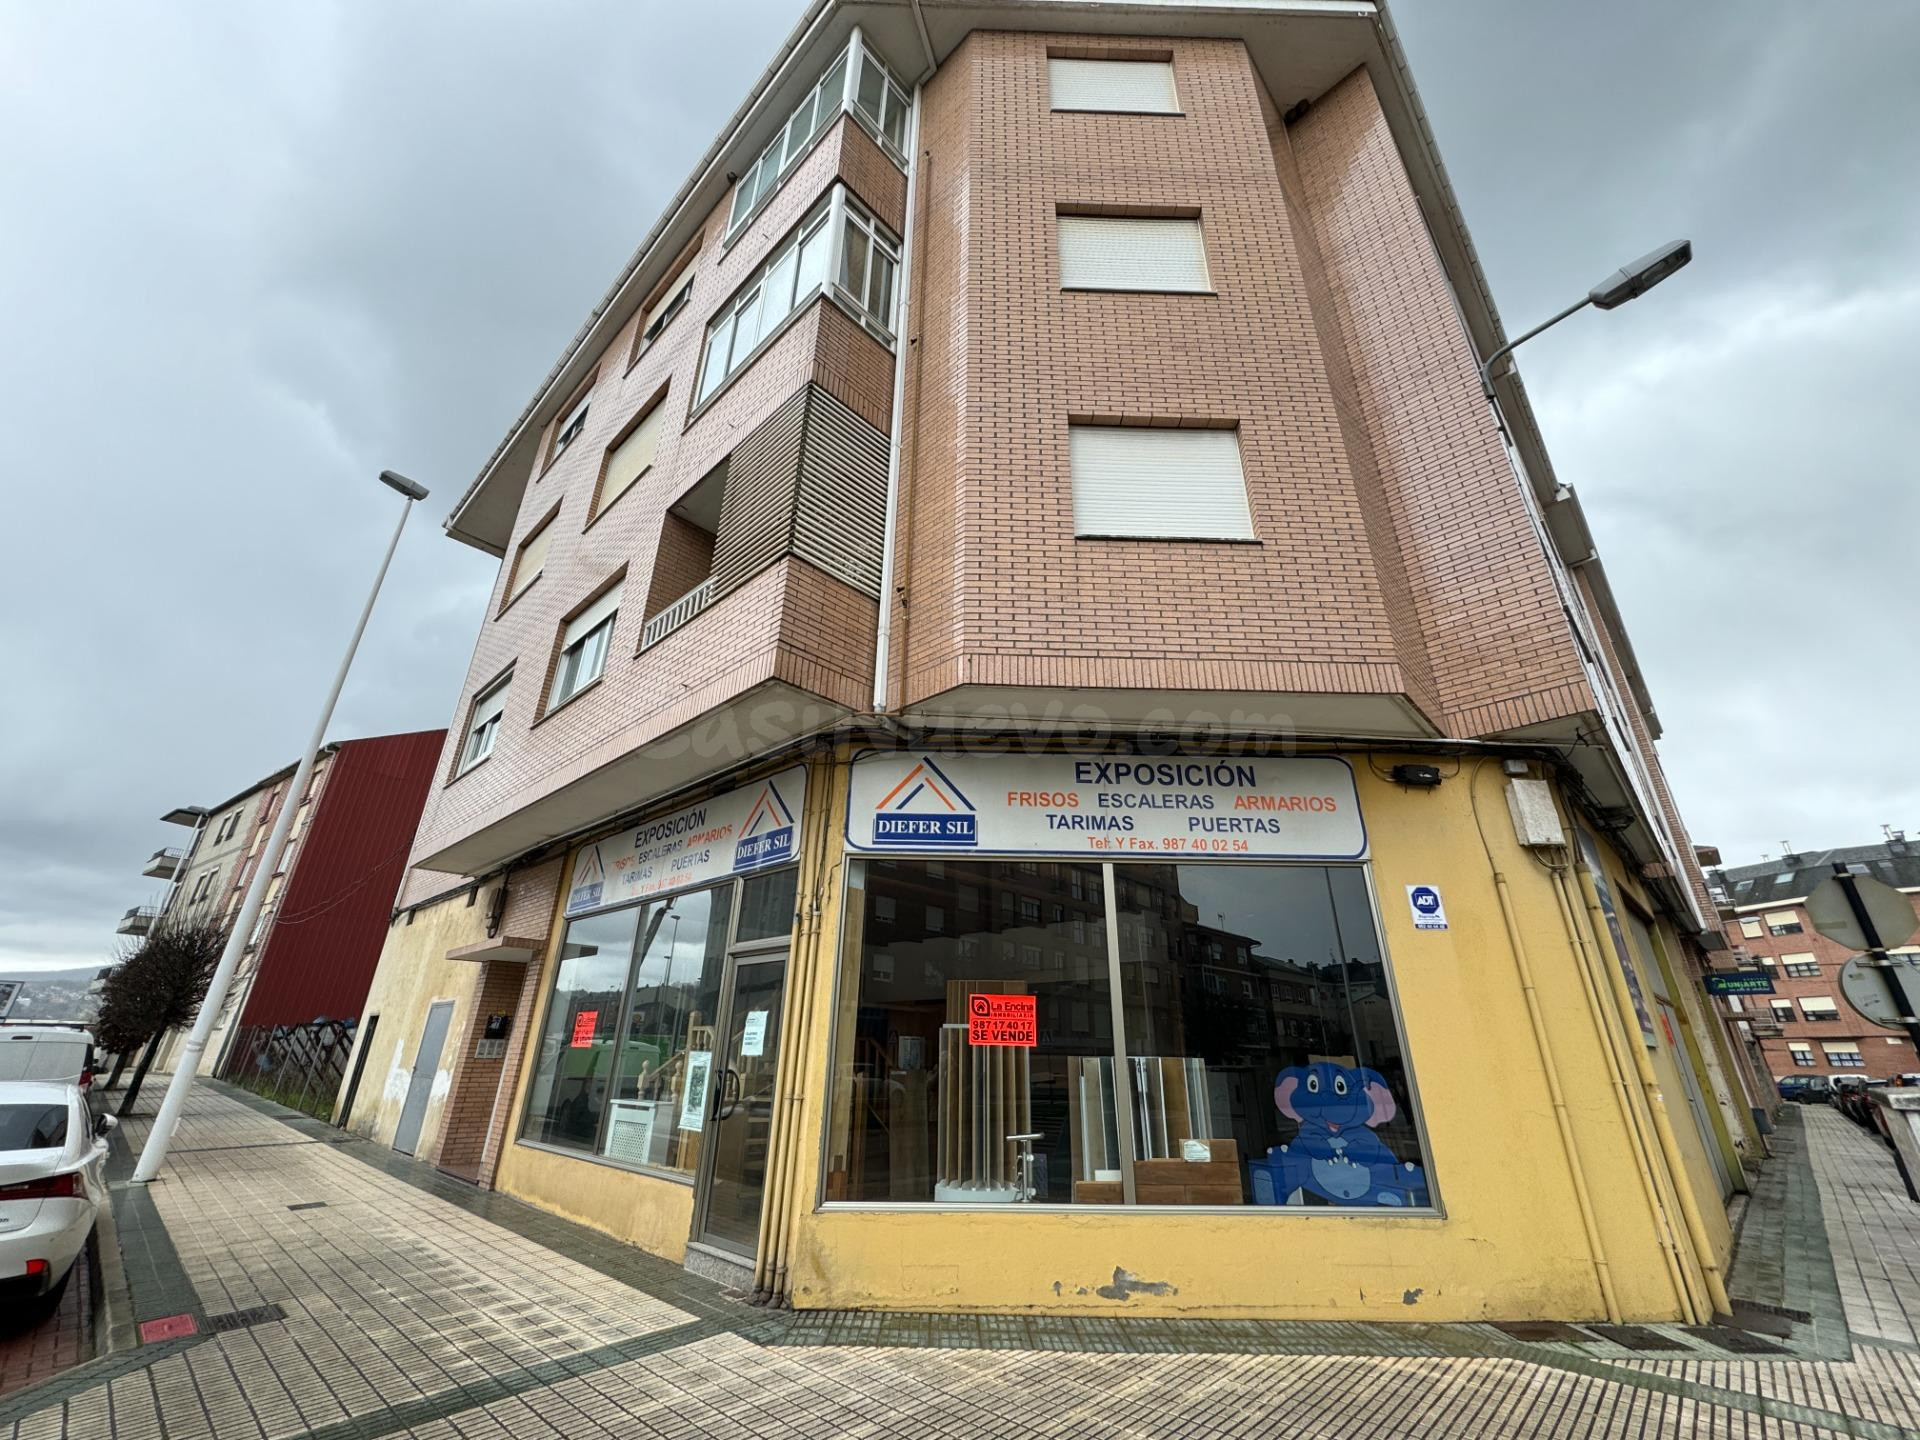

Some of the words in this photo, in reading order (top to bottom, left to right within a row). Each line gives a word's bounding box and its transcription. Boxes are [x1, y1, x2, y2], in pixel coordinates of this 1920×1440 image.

[1074, 760, 1257, 788] EXPOSICIÓN
[1007, 791, 1080, 808] FRISOS
[1097, 793, 1215, 810] ESCALERAS
[1234, 795, 1337, 812] ARMARIOS
[635, 807, 708, 849] EXPOSICIÓN
[878, 820, 942, 834] DIEFER
[946, 821, 974, 835] SIL
[1045, 814, 1135, 832] TARIMAS
[1188, 816, 1281, 834] PUERTAS
[638, 839, 683, 866] ESCALERAS
[686, 824, 733, 849] ARMARIOS
[736, 838, 772, 860] DIEFER
[773, 833, 790, 850] SIL
[1115, 836, 1125, 849] Y
[1129, 837, 1159, 850] Fax.
[1162, 837, 1186, 850] 987
[1191, 838, 1208, 851] 40
[1212, 839, 1229, 852] 02
[1232, 839, 1249, 852] 54
[671, 849, 711, 872] PUERTAS
[1416, 895, 1434, 906] ADT
[991, 1002, 1003, 1011] La
[1004, 1002, 1034, 1012] Encina
[972, 1030, 988, 1041] SE
[992, 1030, 1033, 1042] VENDE
[973, 1021, 992, 1030] 987
[993, 1021, 1006, 1030] 17
[1007, 1021, 1019, 1030] 40
[1021, 1021, 1033, 1031] 17
